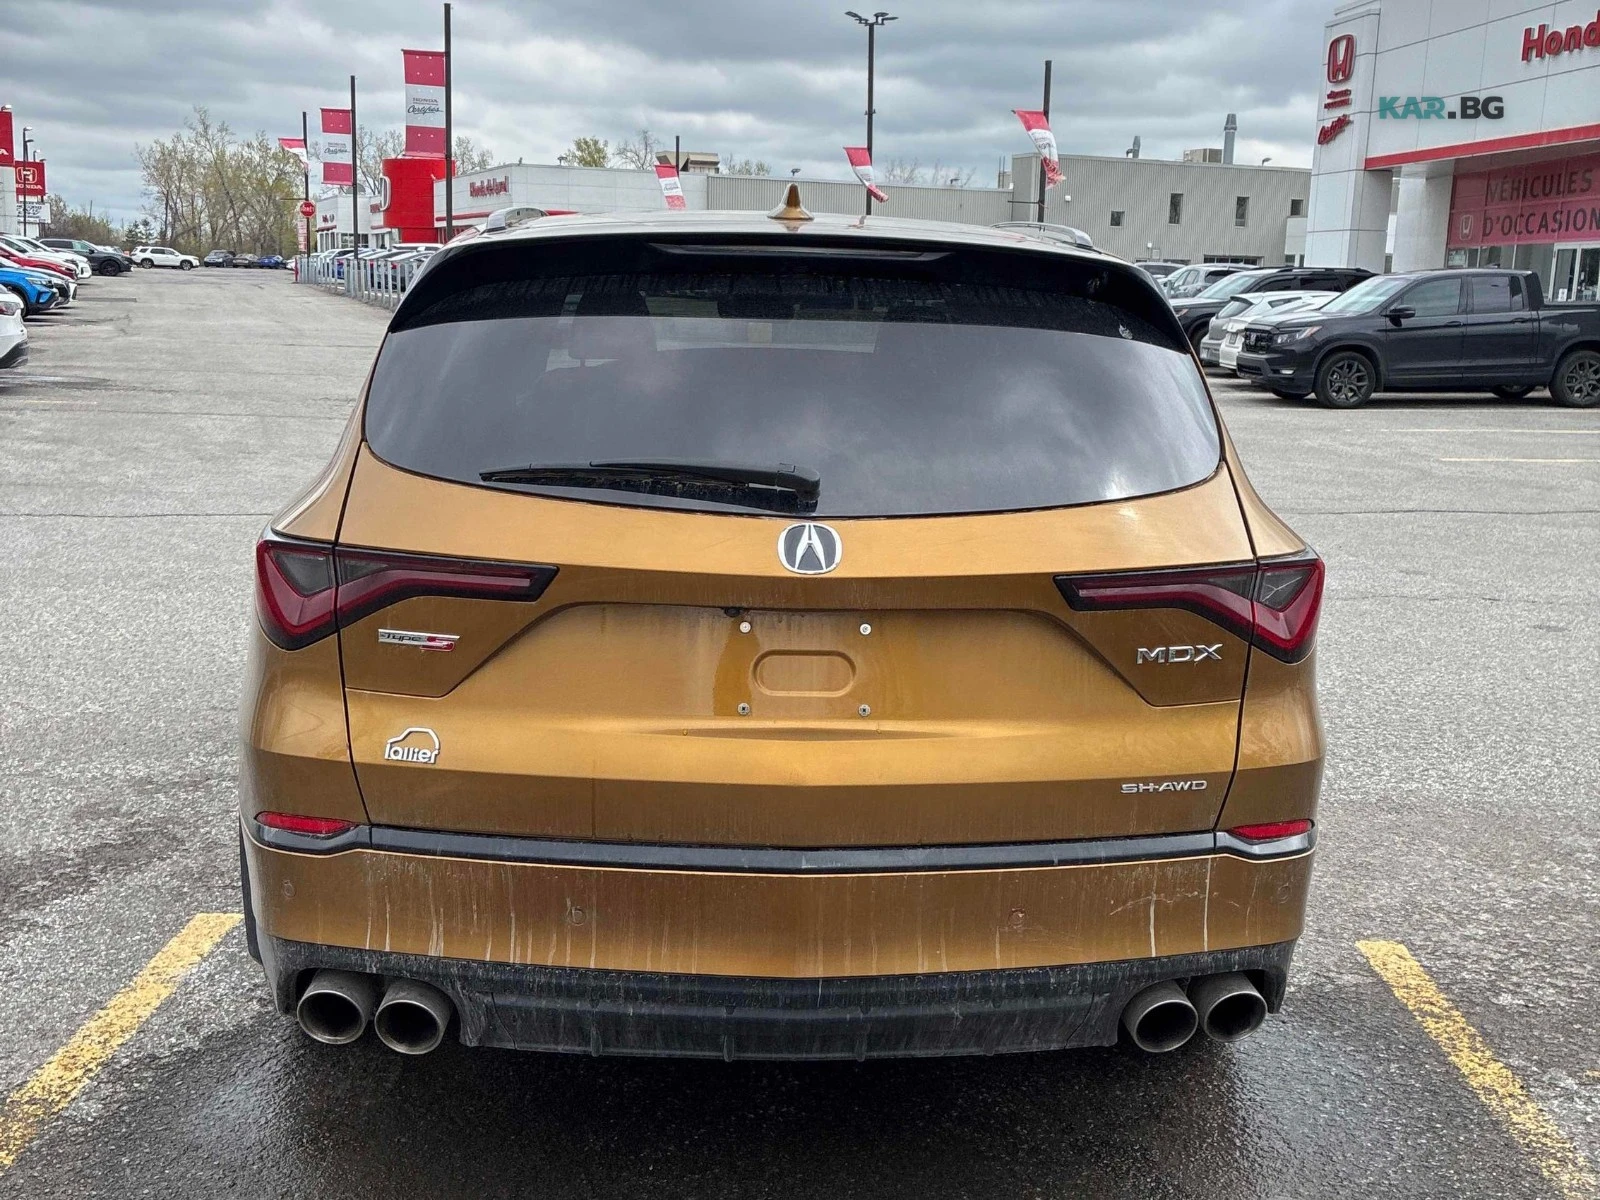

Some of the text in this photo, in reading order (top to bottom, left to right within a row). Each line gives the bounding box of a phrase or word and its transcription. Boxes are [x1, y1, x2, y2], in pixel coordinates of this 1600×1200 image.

[1487, 169, 1593, 204] VÉHICULES
[381, 631, 456, 652] Type S
[1136, 643, 1224, 665] MDX
[1120, 780, 1208, 794] SH-AWD
